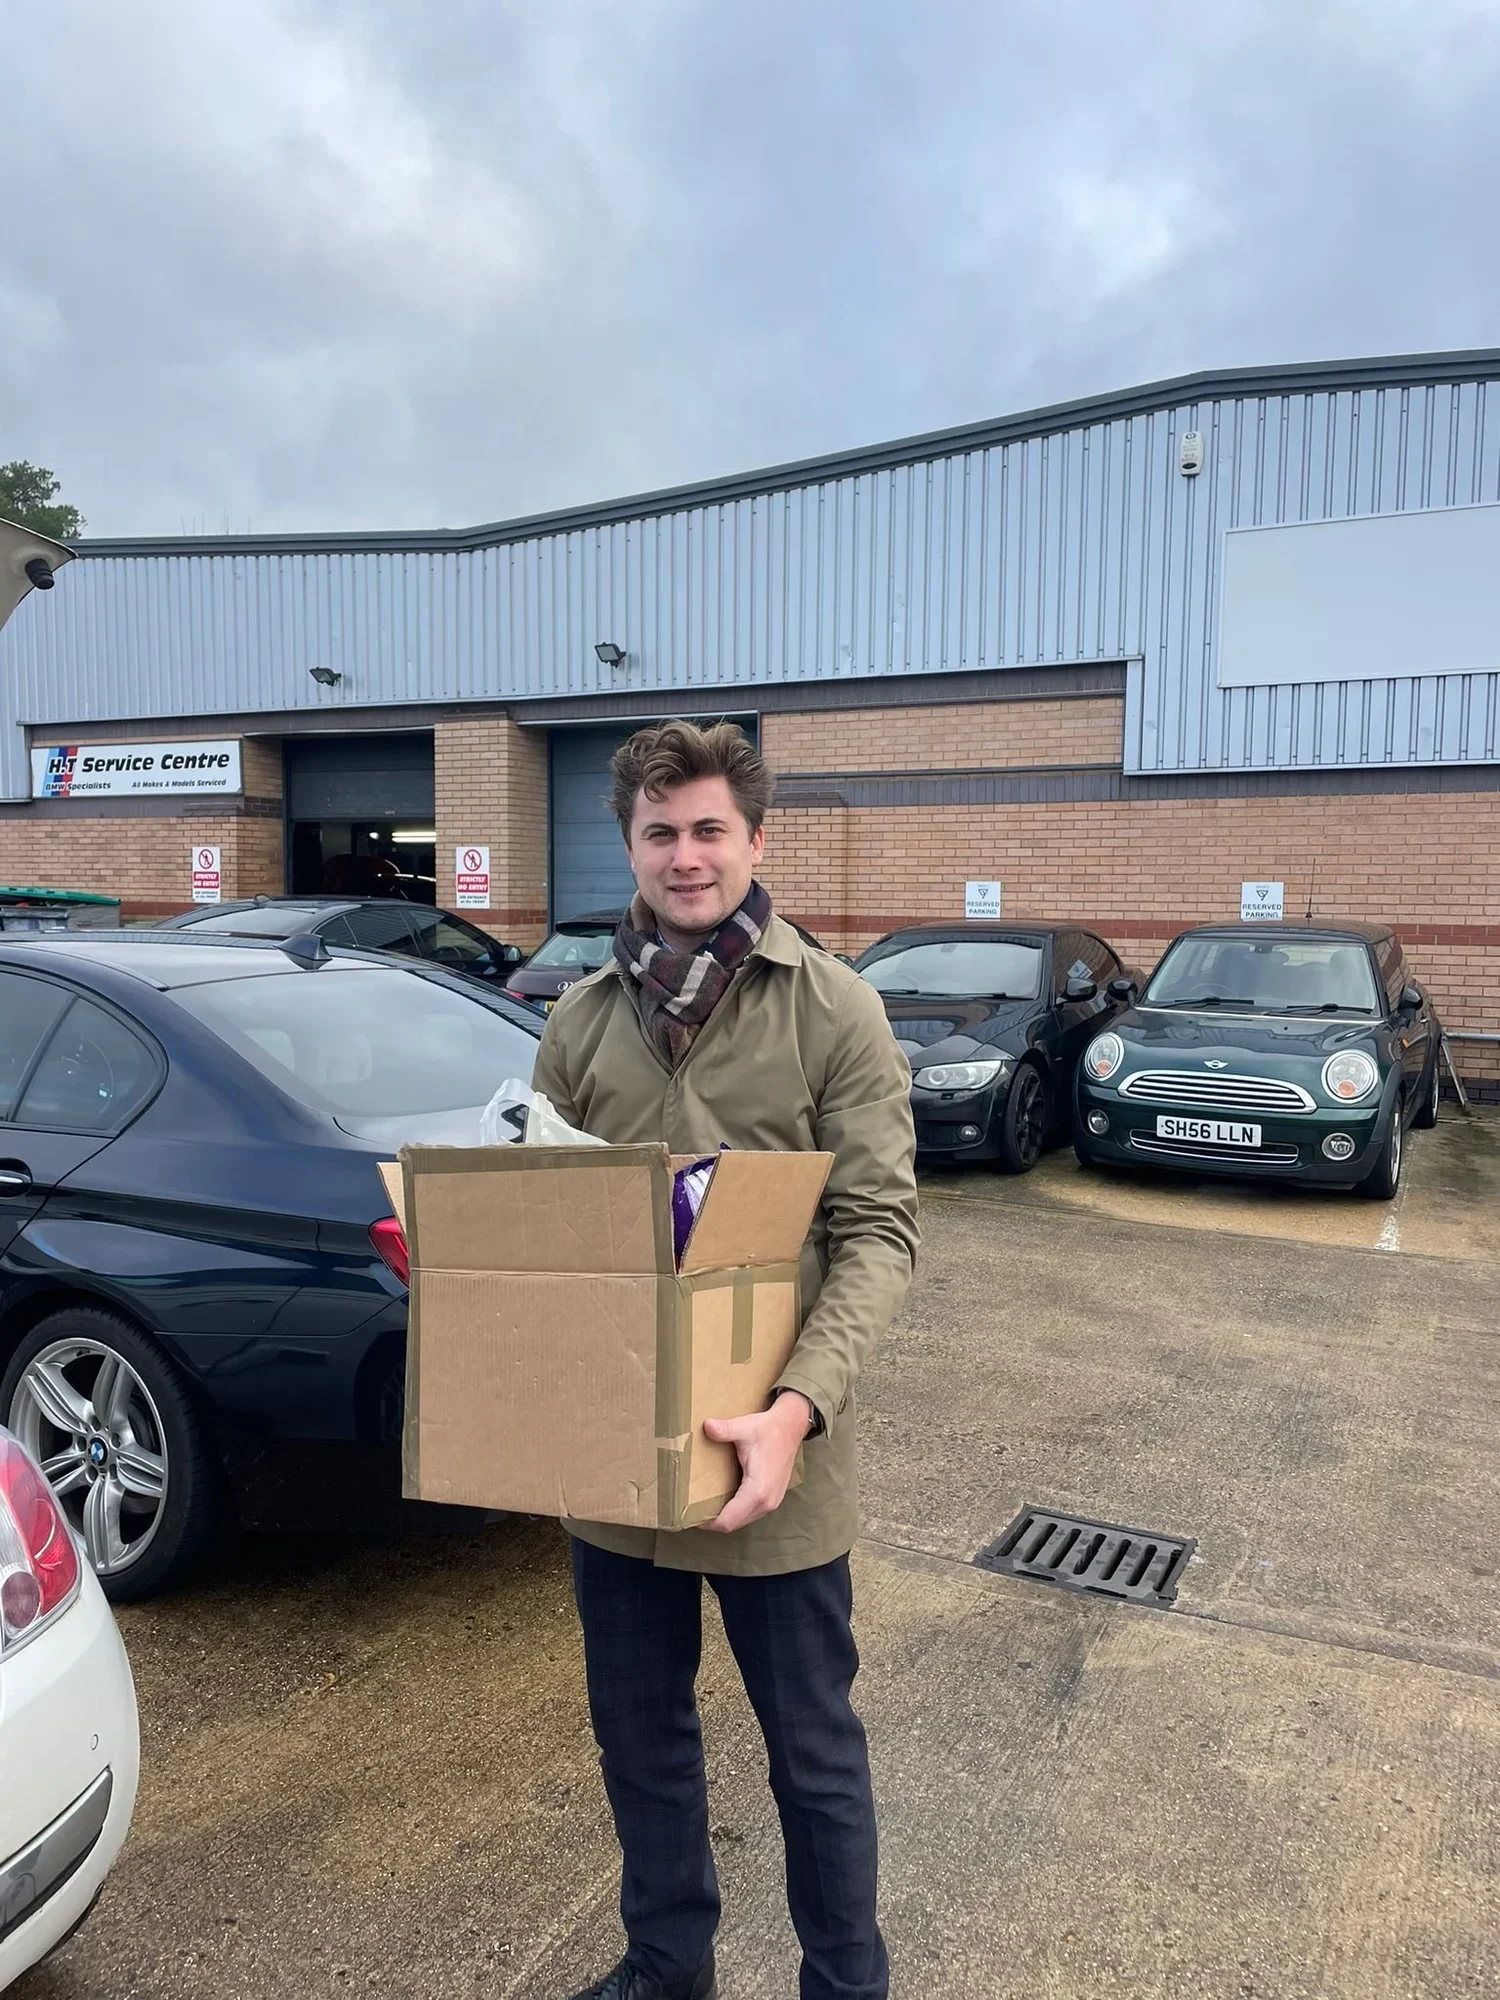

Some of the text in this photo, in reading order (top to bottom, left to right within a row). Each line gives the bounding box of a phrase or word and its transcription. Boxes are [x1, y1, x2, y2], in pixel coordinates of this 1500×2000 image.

[48, 752, 230, 773] H.T Service Centre
[67, 782, 111, 791] Specialists
[197, 779, 227, 787] Serviced
[1164, 1119, 1253, 1143] SH56 LLN
